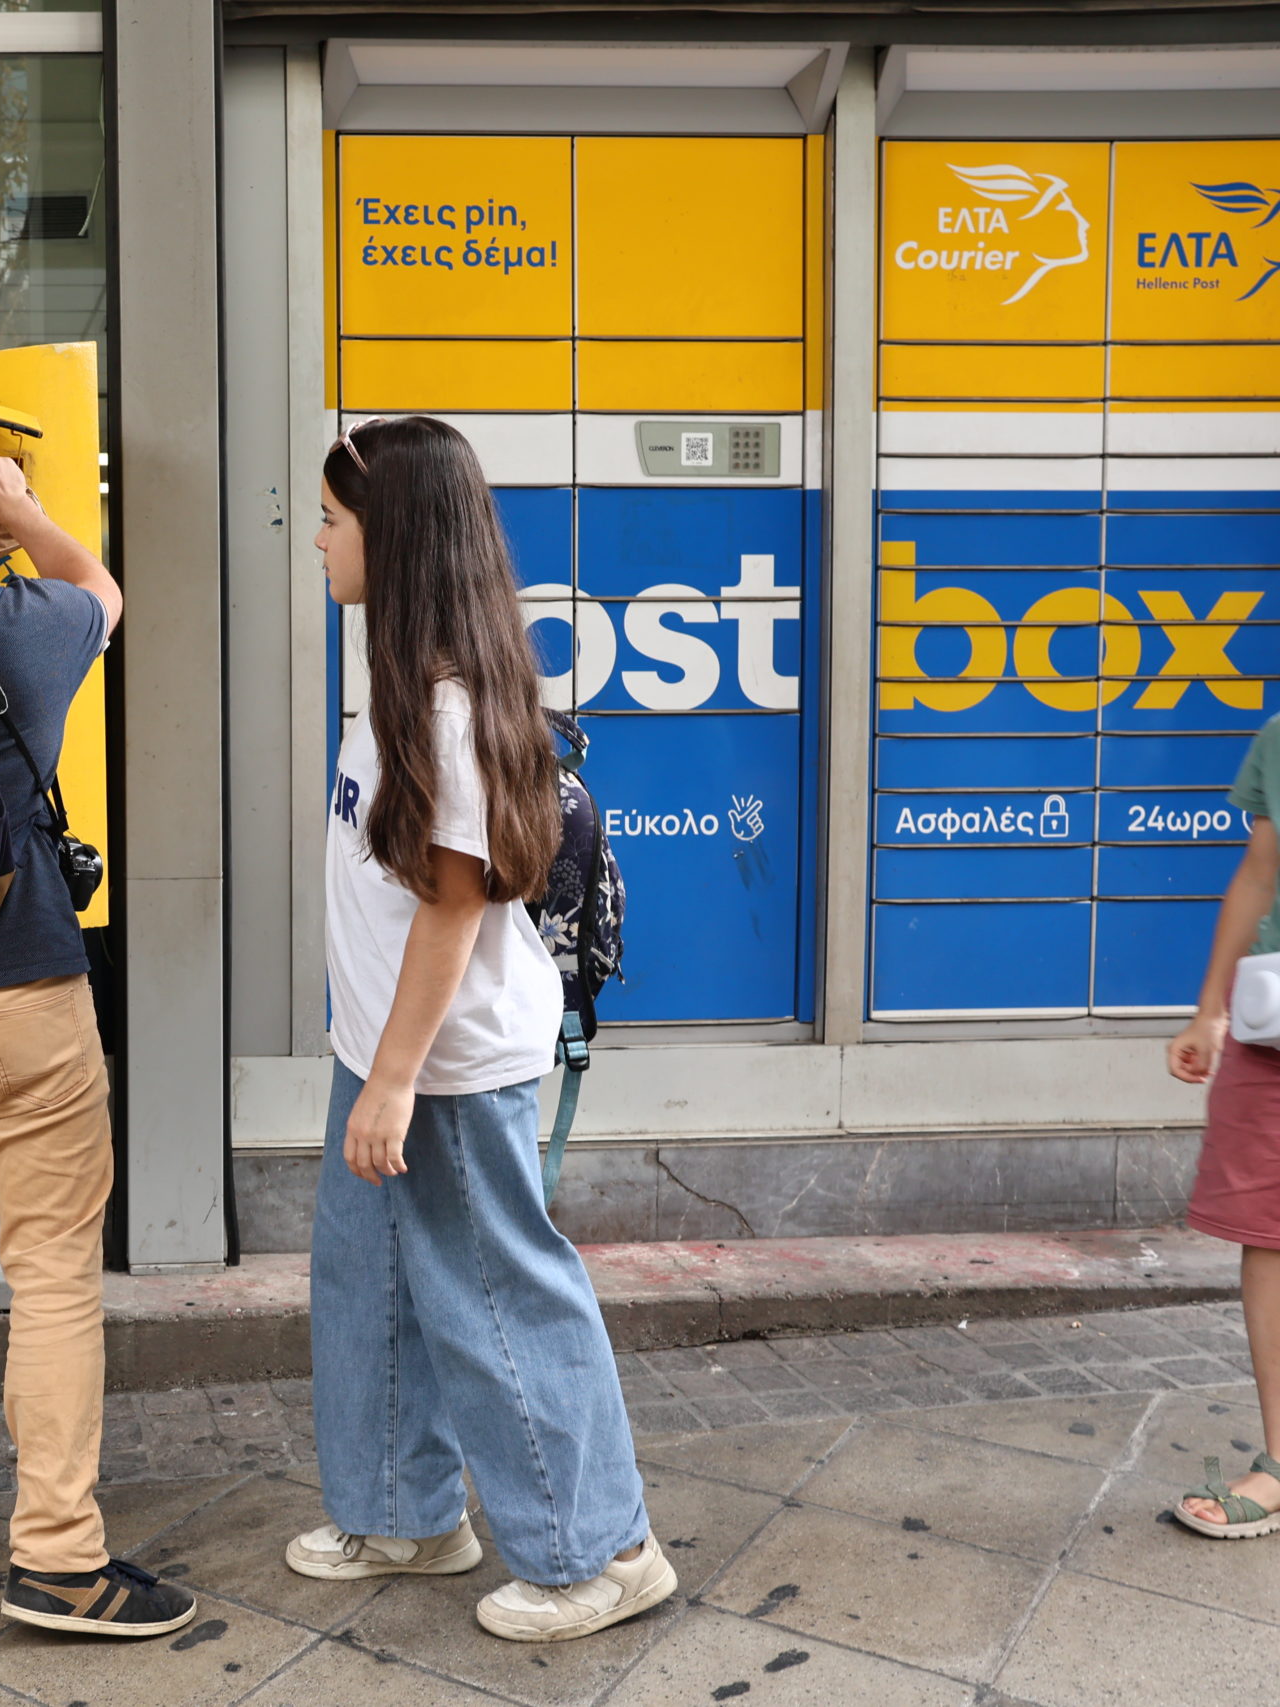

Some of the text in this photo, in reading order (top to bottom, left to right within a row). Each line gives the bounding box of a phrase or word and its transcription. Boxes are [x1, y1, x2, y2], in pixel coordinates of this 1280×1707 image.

[355, 197, 527, 234] Έχεις pin,
[938, 207, 1009, 234] ΕΛΤΑ
[361, 236, 558, 275] έχεις δέμα!
[894, 240, 1020, 271] Courier
[1136, 231, 1239, 268] ΕΛΤΑ
[1136, 277, 1220, 290] Hellenic Post
[878, 540, 1265, 711] box
[605, 808, 719, 837] Εύκολο
[895, 806, 1034, 840] Ασφαλές
[1127, 804, 1232, 839] 24ωρο
